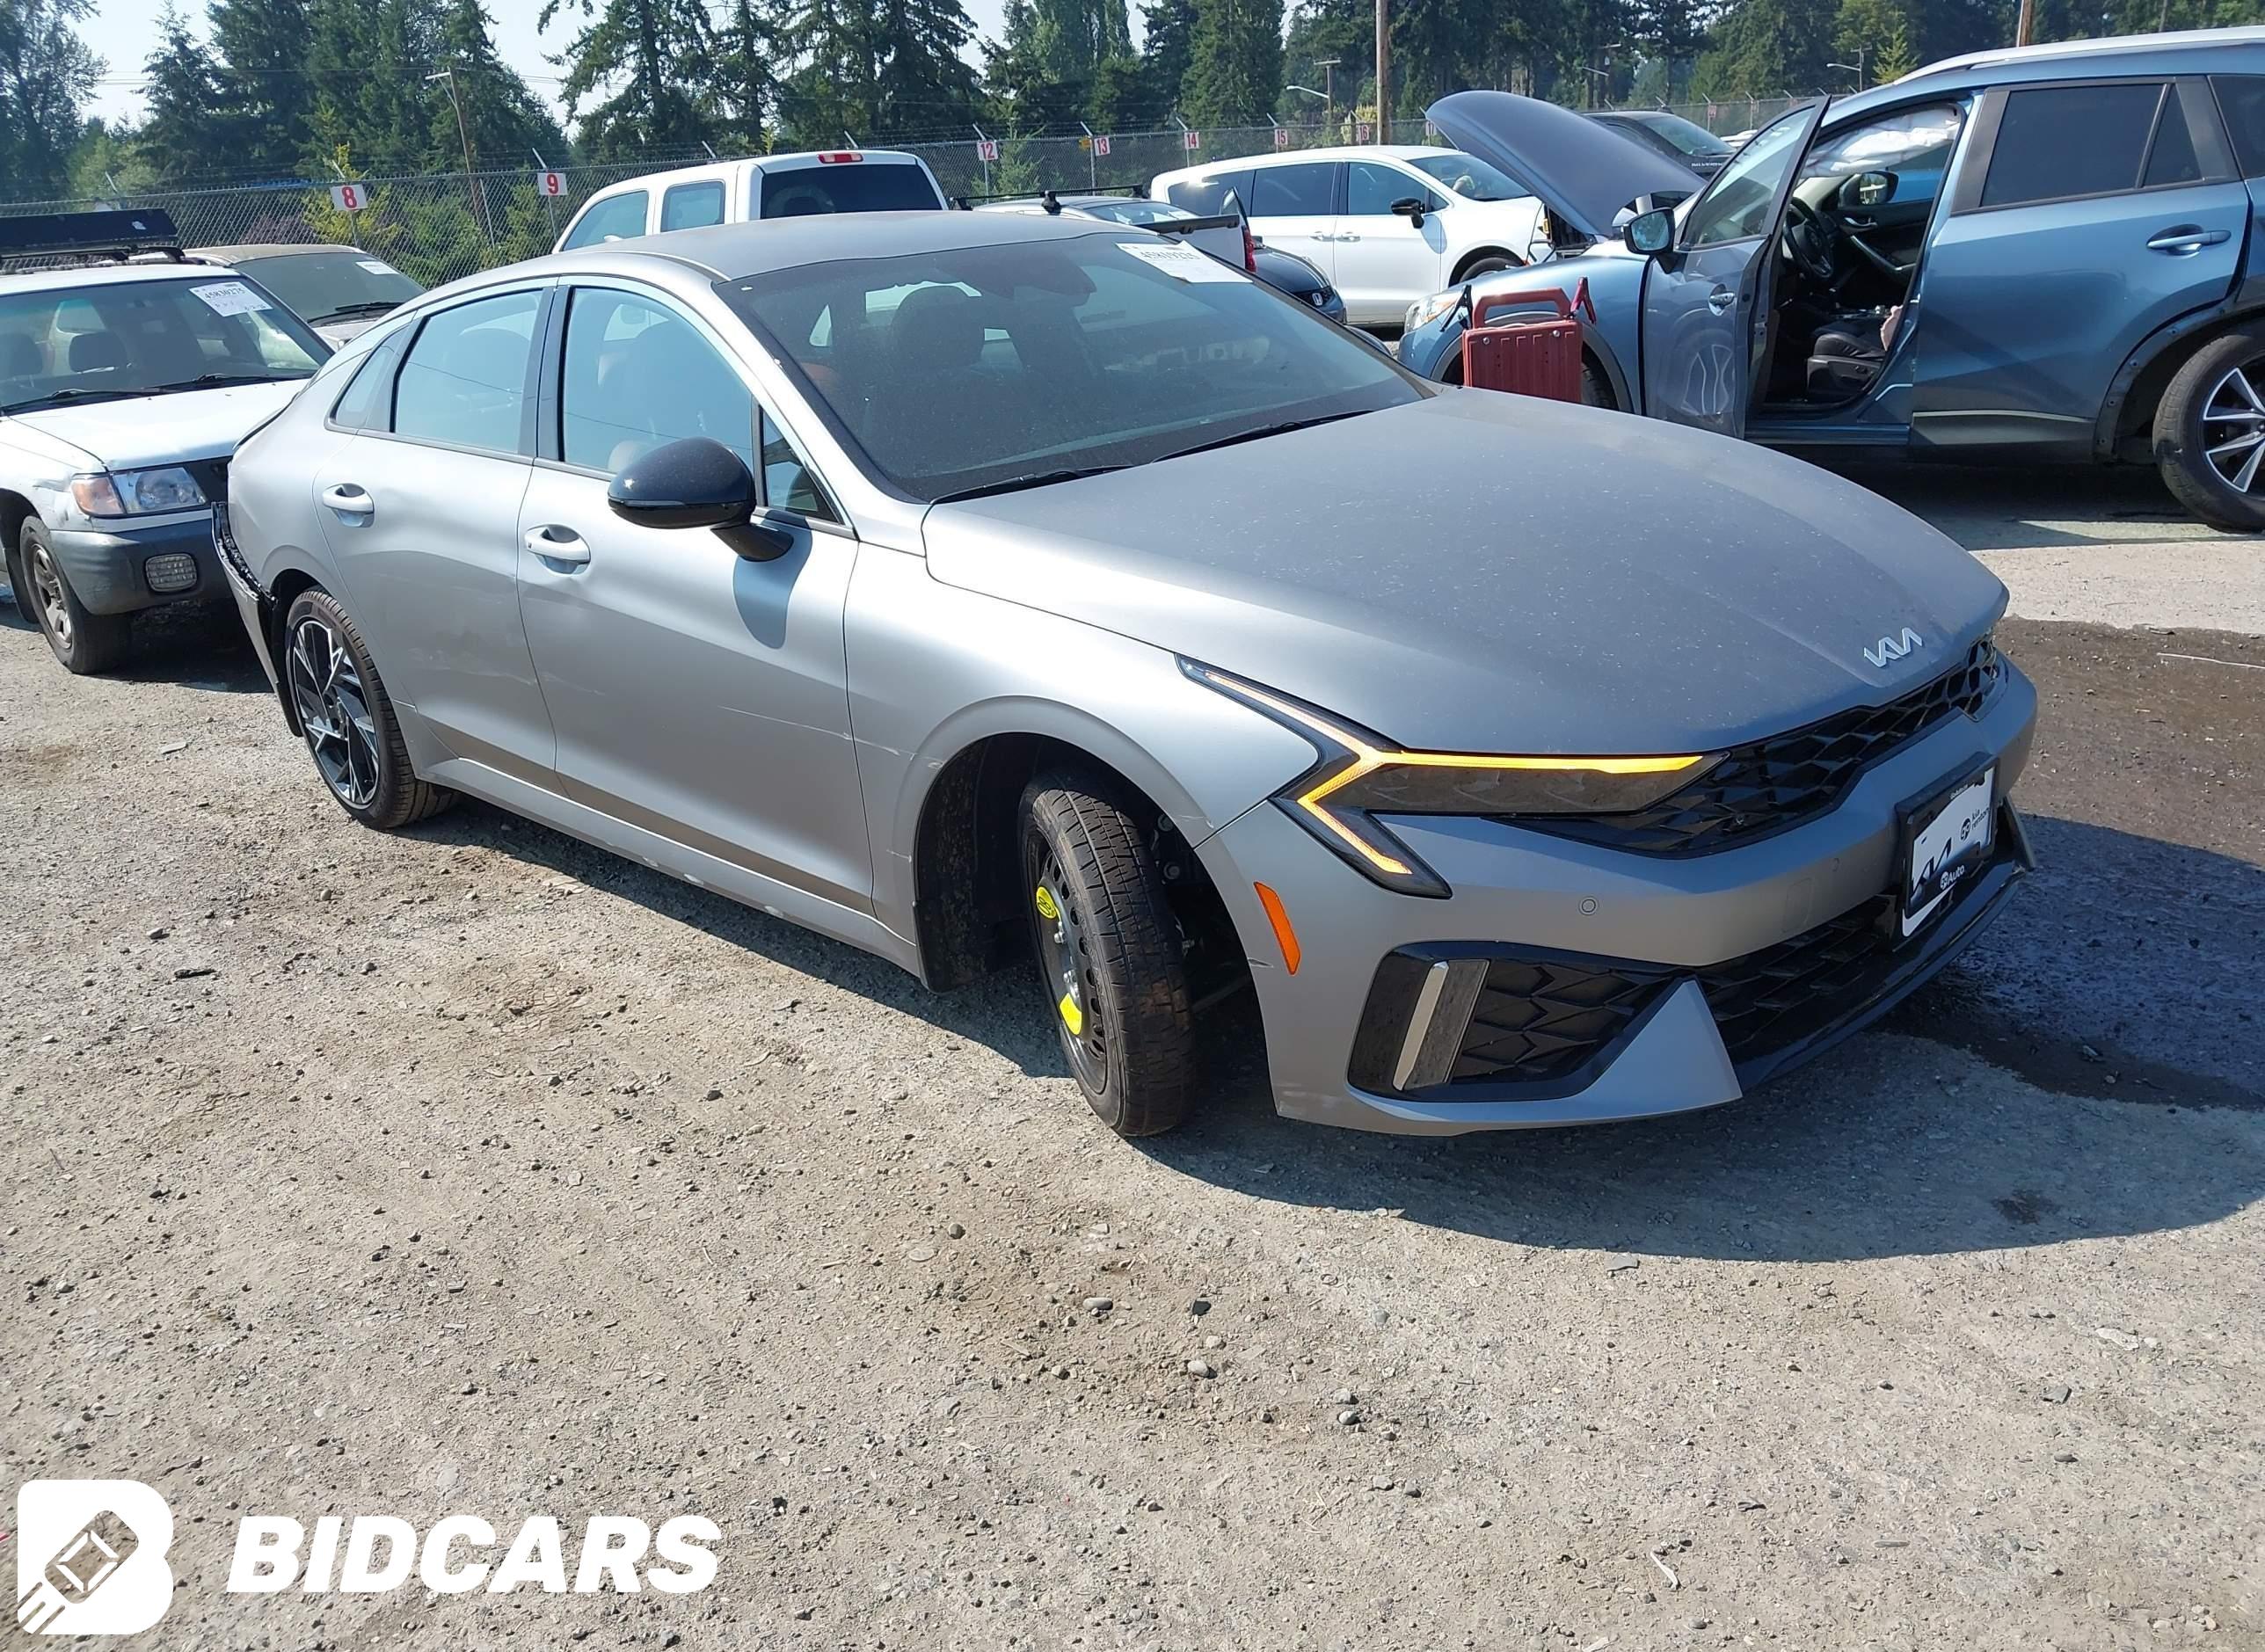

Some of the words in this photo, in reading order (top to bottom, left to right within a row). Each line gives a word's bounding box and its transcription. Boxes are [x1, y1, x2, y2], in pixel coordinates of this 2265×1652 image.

[1187, 133, 1197, 148] 14
[1277, 130, 1286, 144] 15
[1359, 124, 1368, 140] 16
[980, 142, 995, 159] 12
[1096, 138, 1108, 155] 13
[547, 173, 558, 194] 9
[341, 186, 357, 208] 8
[1863, 627, 1923, 667] KIA
